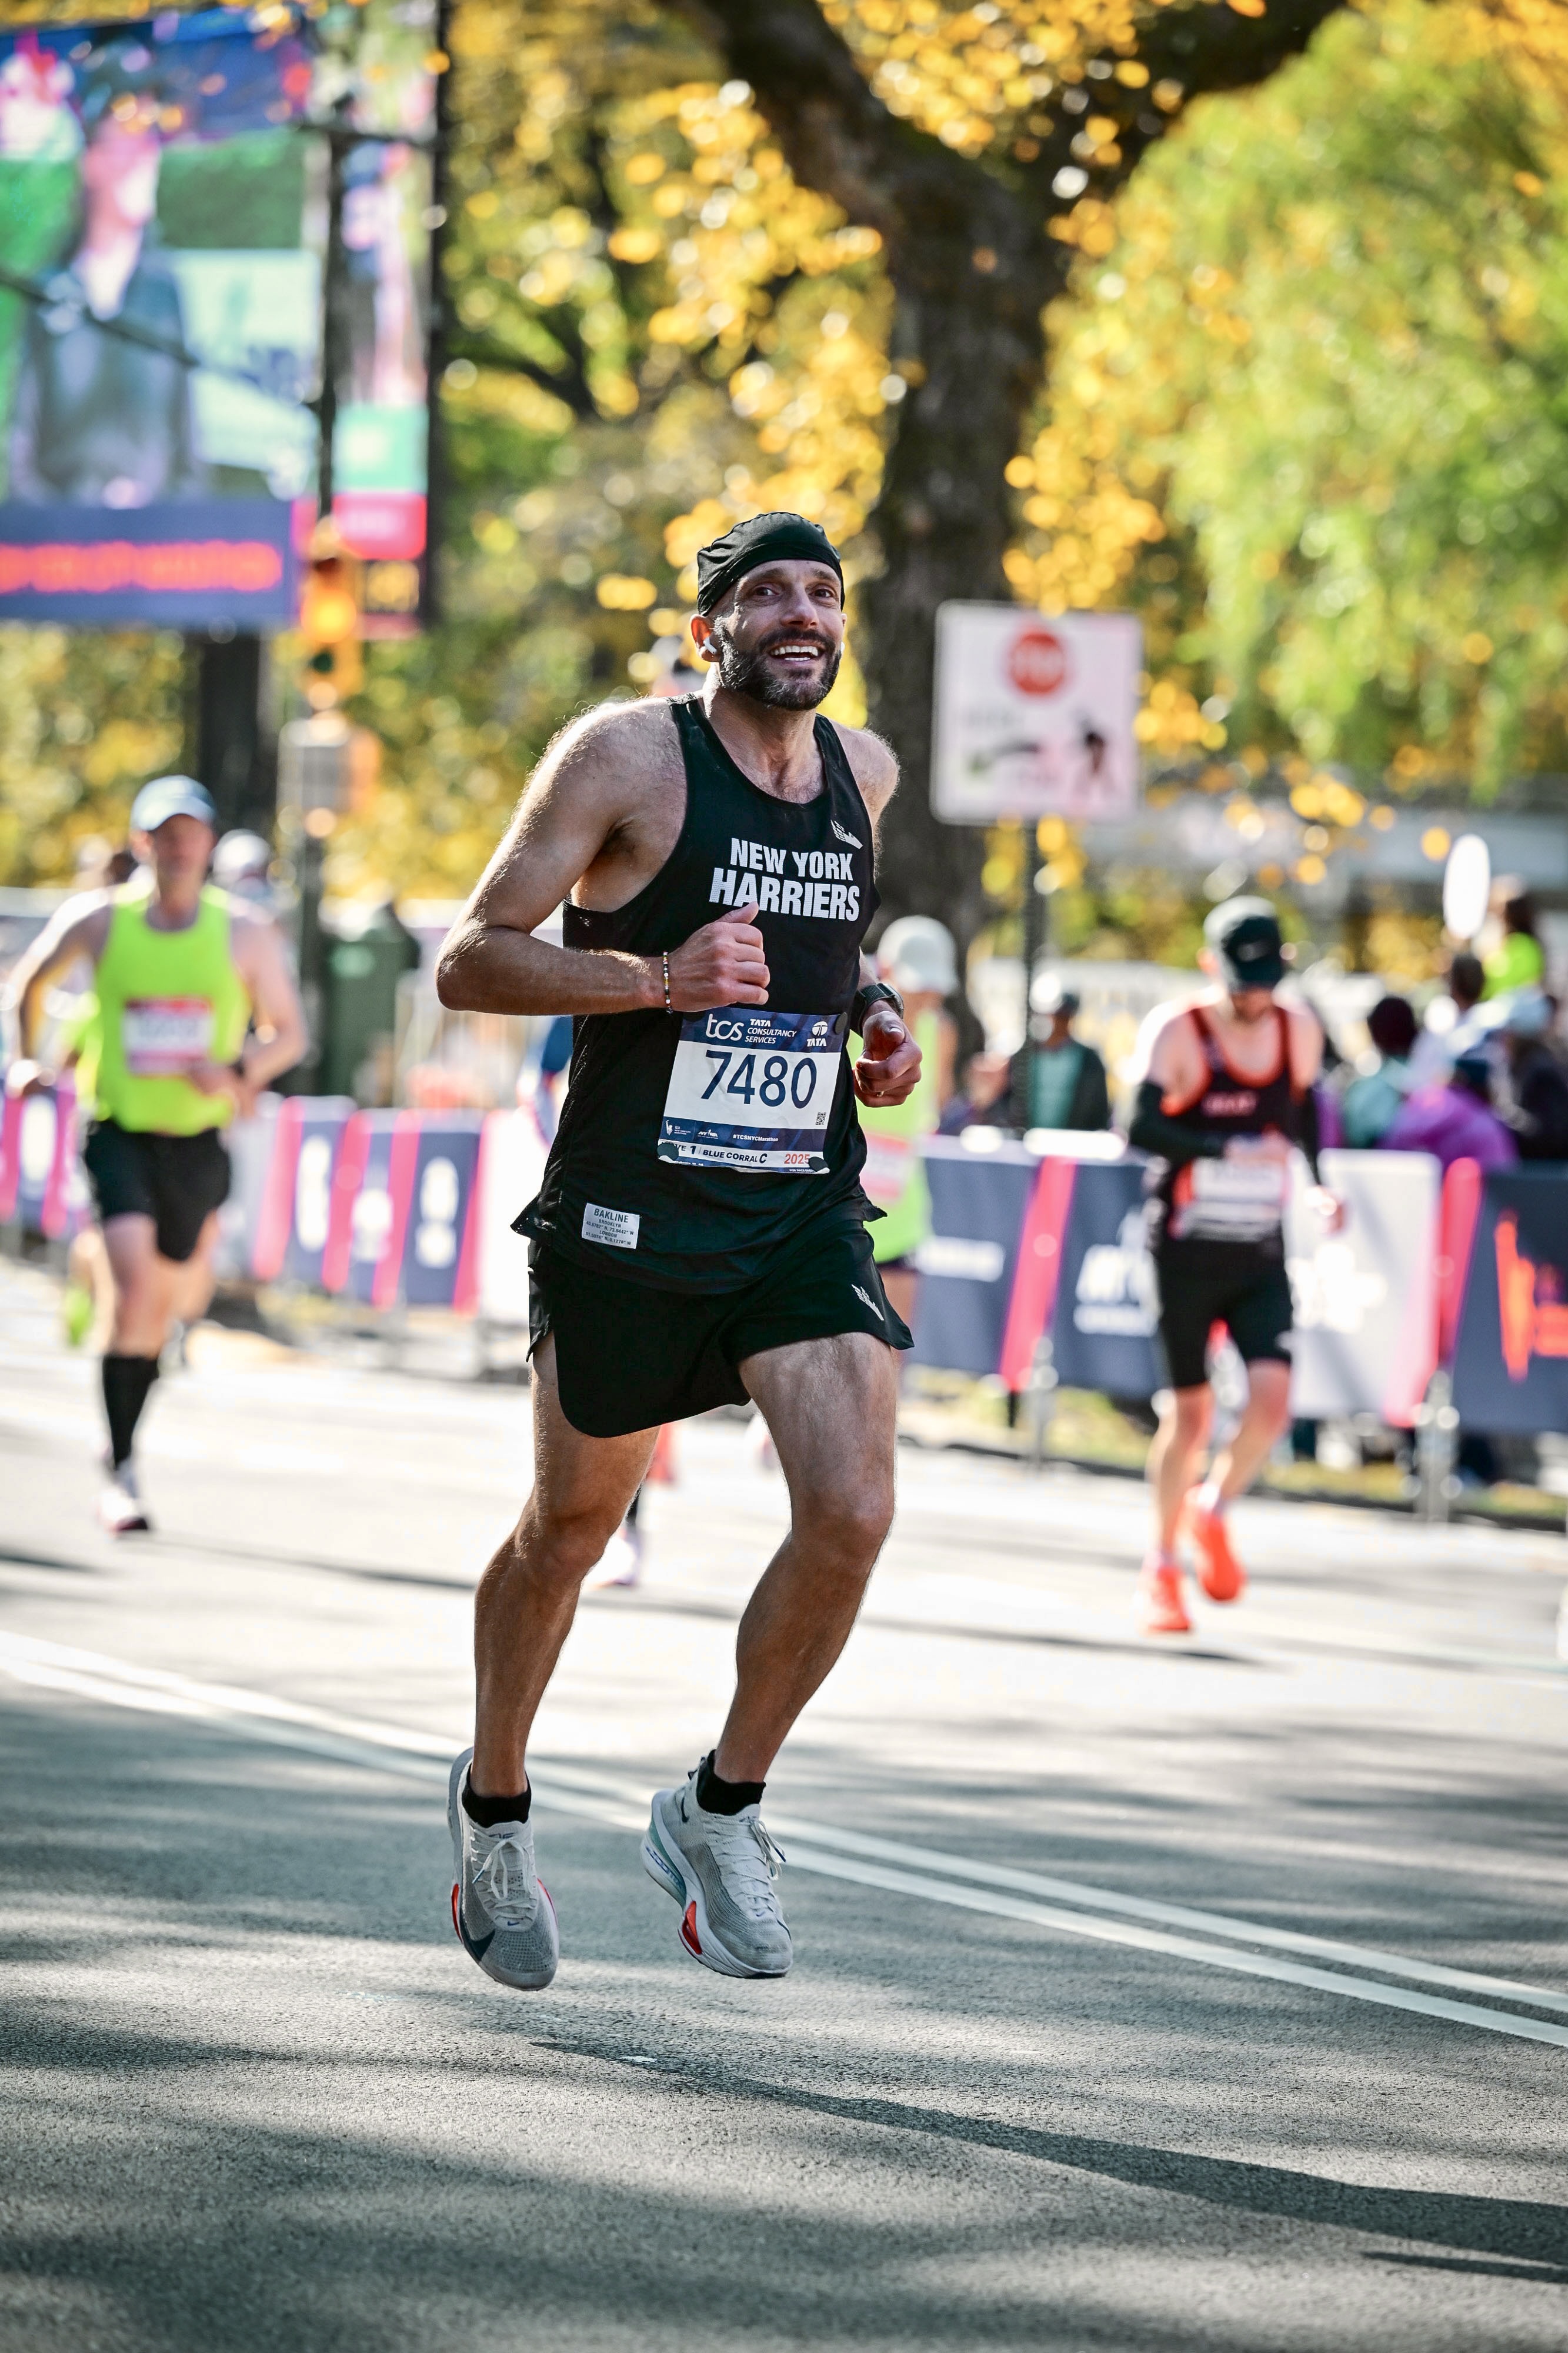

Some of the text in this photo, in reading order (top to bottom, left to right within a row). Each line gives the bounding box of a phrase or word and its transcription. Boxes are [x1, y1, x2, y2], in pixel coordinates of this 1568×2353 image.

[730, 838, 853, 881] NEW YORK
[709, 867, 860, 922] HARRIERS
[706, 1014, 744, 1041] tcs
[750, 1018, 770, 1027] TATA
[747, 1027, 797, 1037] CONSULTANCY
[745, 1035, 776, 1044] SERVICES
[806, 1038, 827, 1047] TATA
[701, 1049, 817, 1109] 7480
[733, 1134, 778, 1142] #TCSNYCMarathon
[690, 1145, 696, 1155] 1
[703, 1149, 725, 1158] BLUE
[726, 1152, 758, 1162] CORRAL
[759, 1153, 768, 1164] C
[784, 1154, 810, 1165] 2025
[594, 1208, 629, 1223] BAKLINE
[599, 1219, 621, 1228] BROOKLYN
